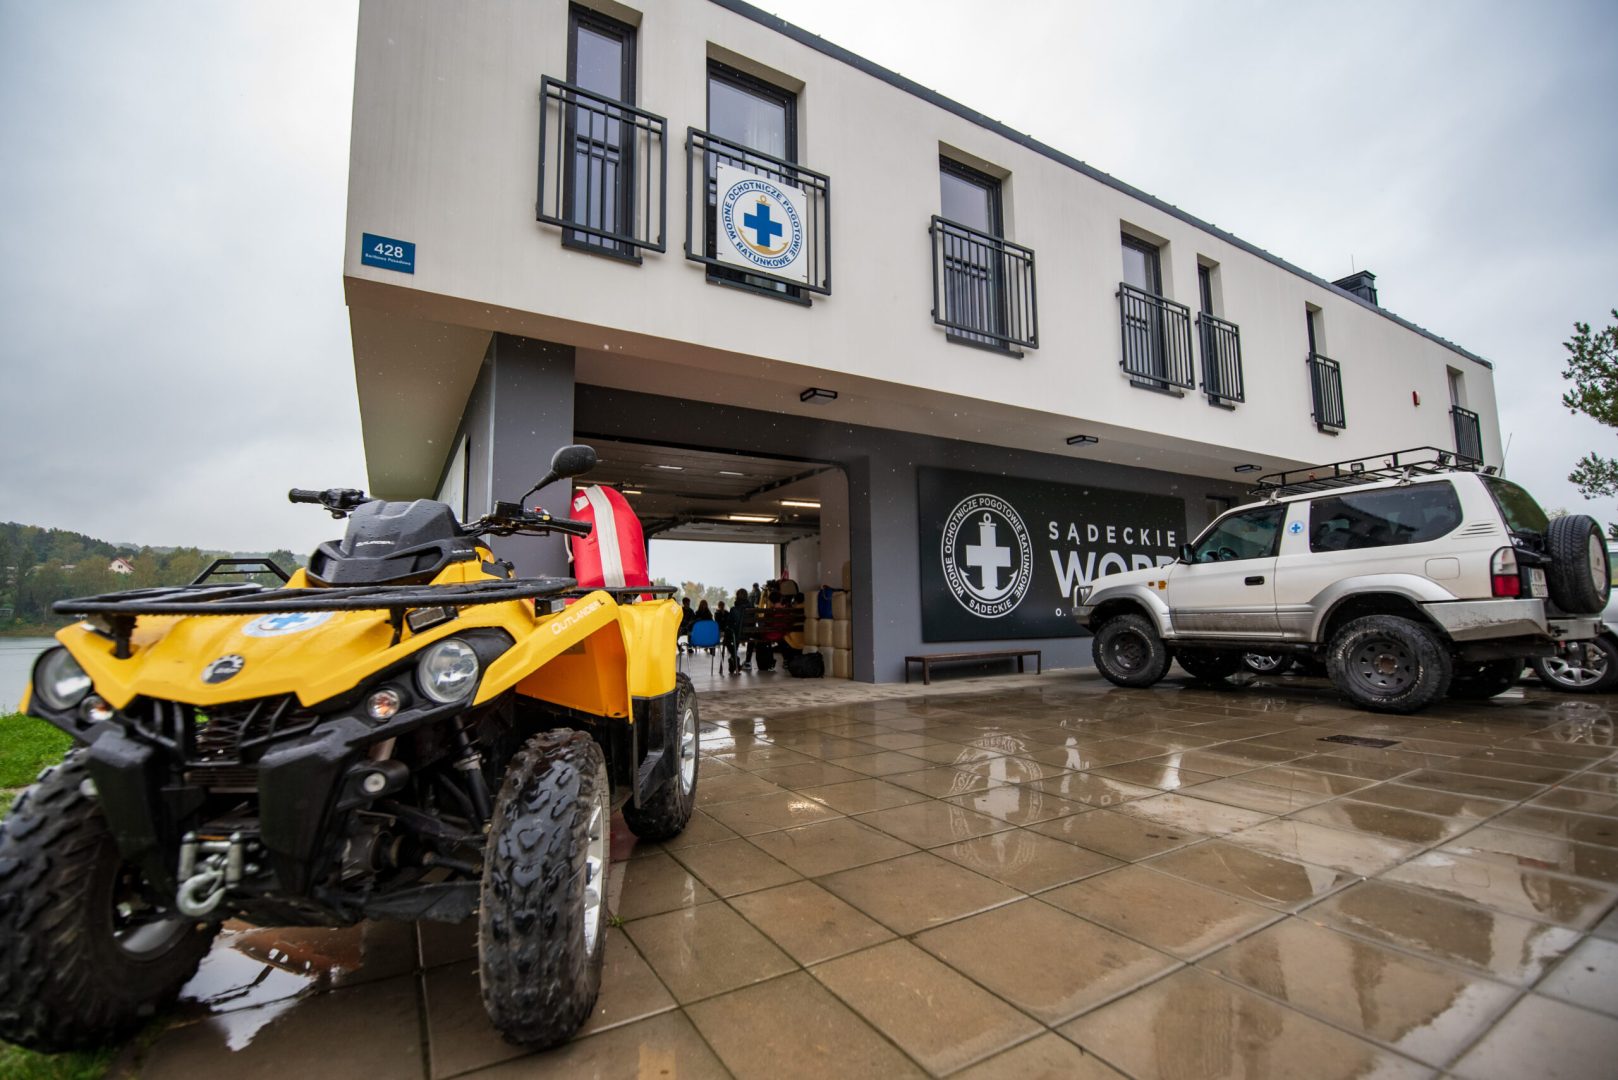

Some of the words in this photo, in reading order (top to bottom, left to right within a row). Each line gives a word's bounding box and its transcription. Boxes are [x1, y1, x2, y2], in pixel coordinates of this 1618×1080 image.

[729, 181, 782, 201] OCHOTNICZE
[724, 202, 737, 240] WODNE
[783, 200, 802, 257] POGOTOWIE
[374, 242, 403, 258] 428
[736, 242, 791, 267] RATUNKOWE
[945, 497, 979, 553] OCHOTNICZE
[978, 496, 1024, 534] POGOTOWIE
[1048, 520, 1177, 548] SĄDECKIE
[944, 557, 965, 598] WODNE
[1014, 532, 1031, 600] RATUNKOWE
[968, 598, 1014, 615] SĄDECKIE
